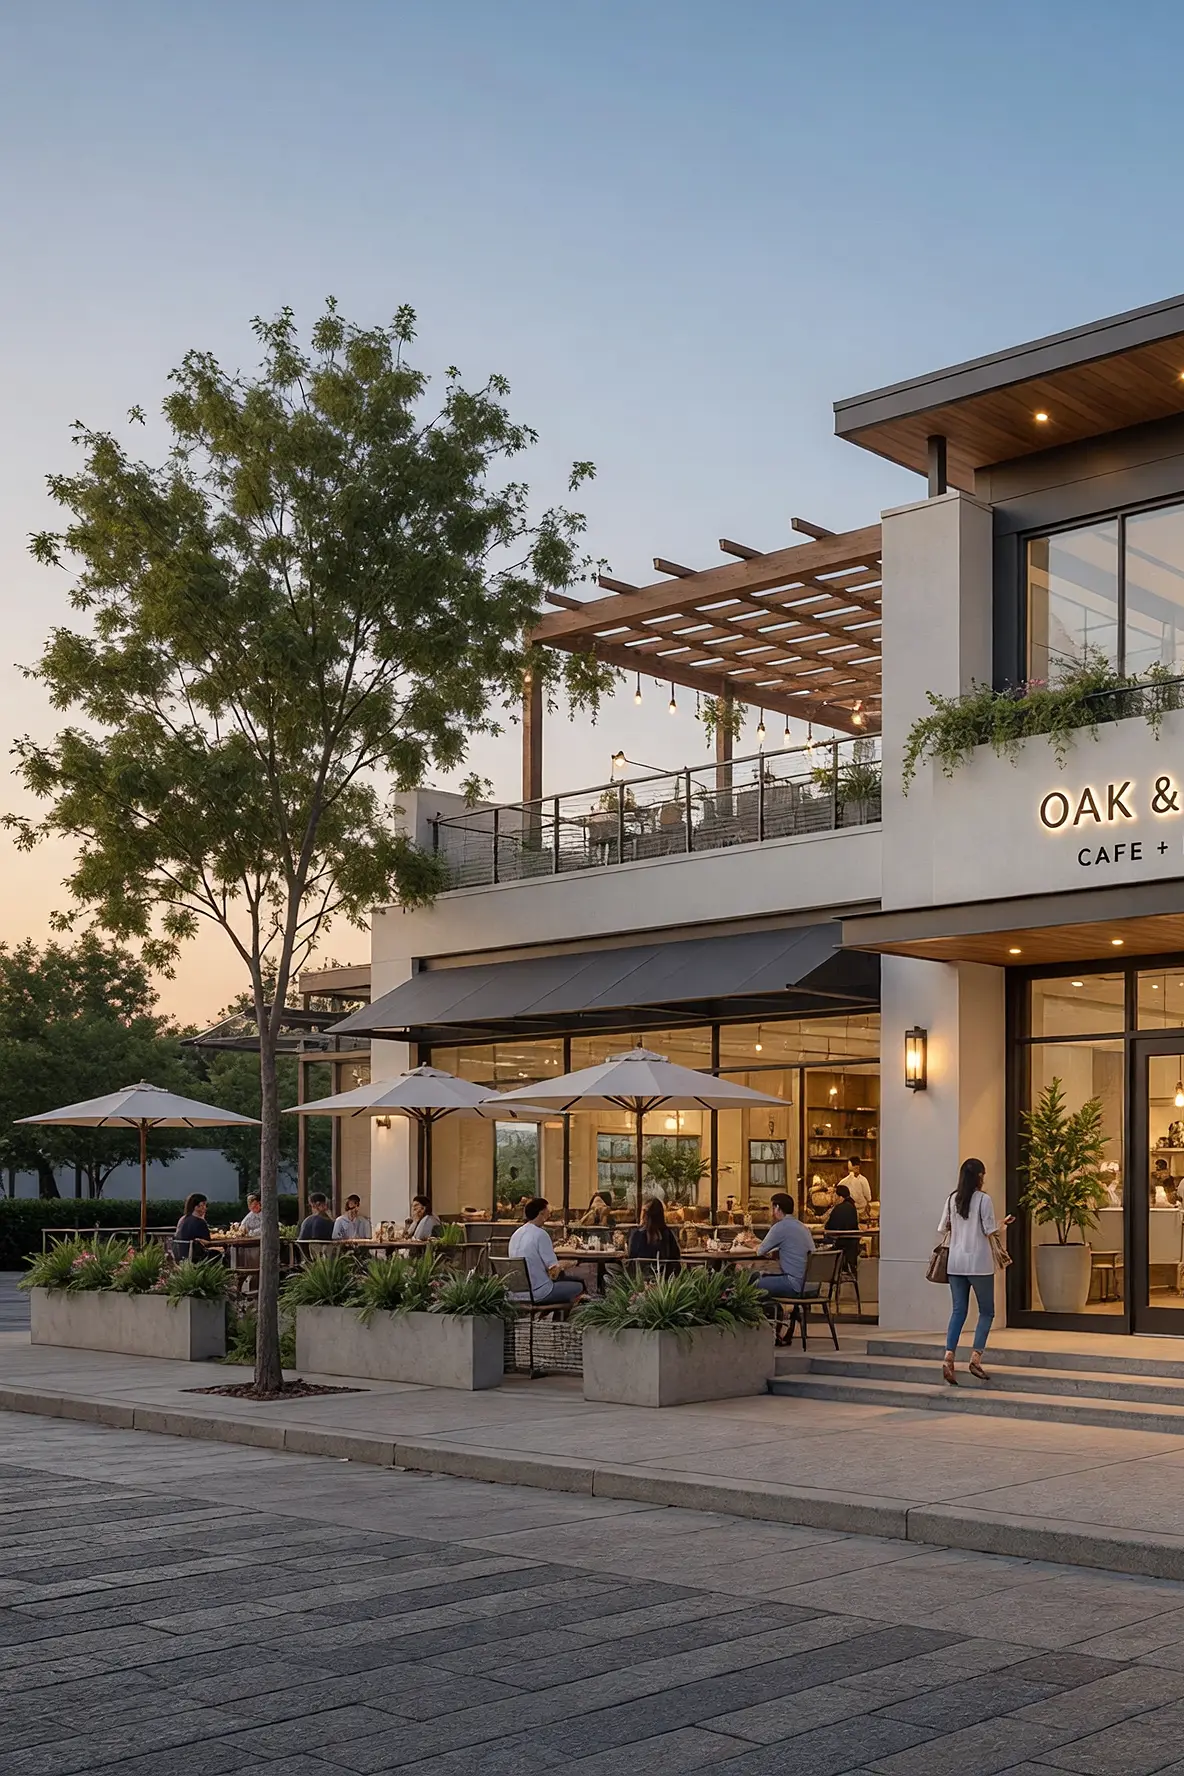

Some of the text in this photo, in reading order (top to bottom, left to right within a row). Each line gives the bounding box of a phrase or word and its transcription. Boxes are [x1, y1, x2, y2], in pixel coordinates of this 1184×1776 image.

[1040, 781, 1133, 829] OAK
[1151, 776, 1182, 814] &
[1077, 842, 1143, 867] CAFE
